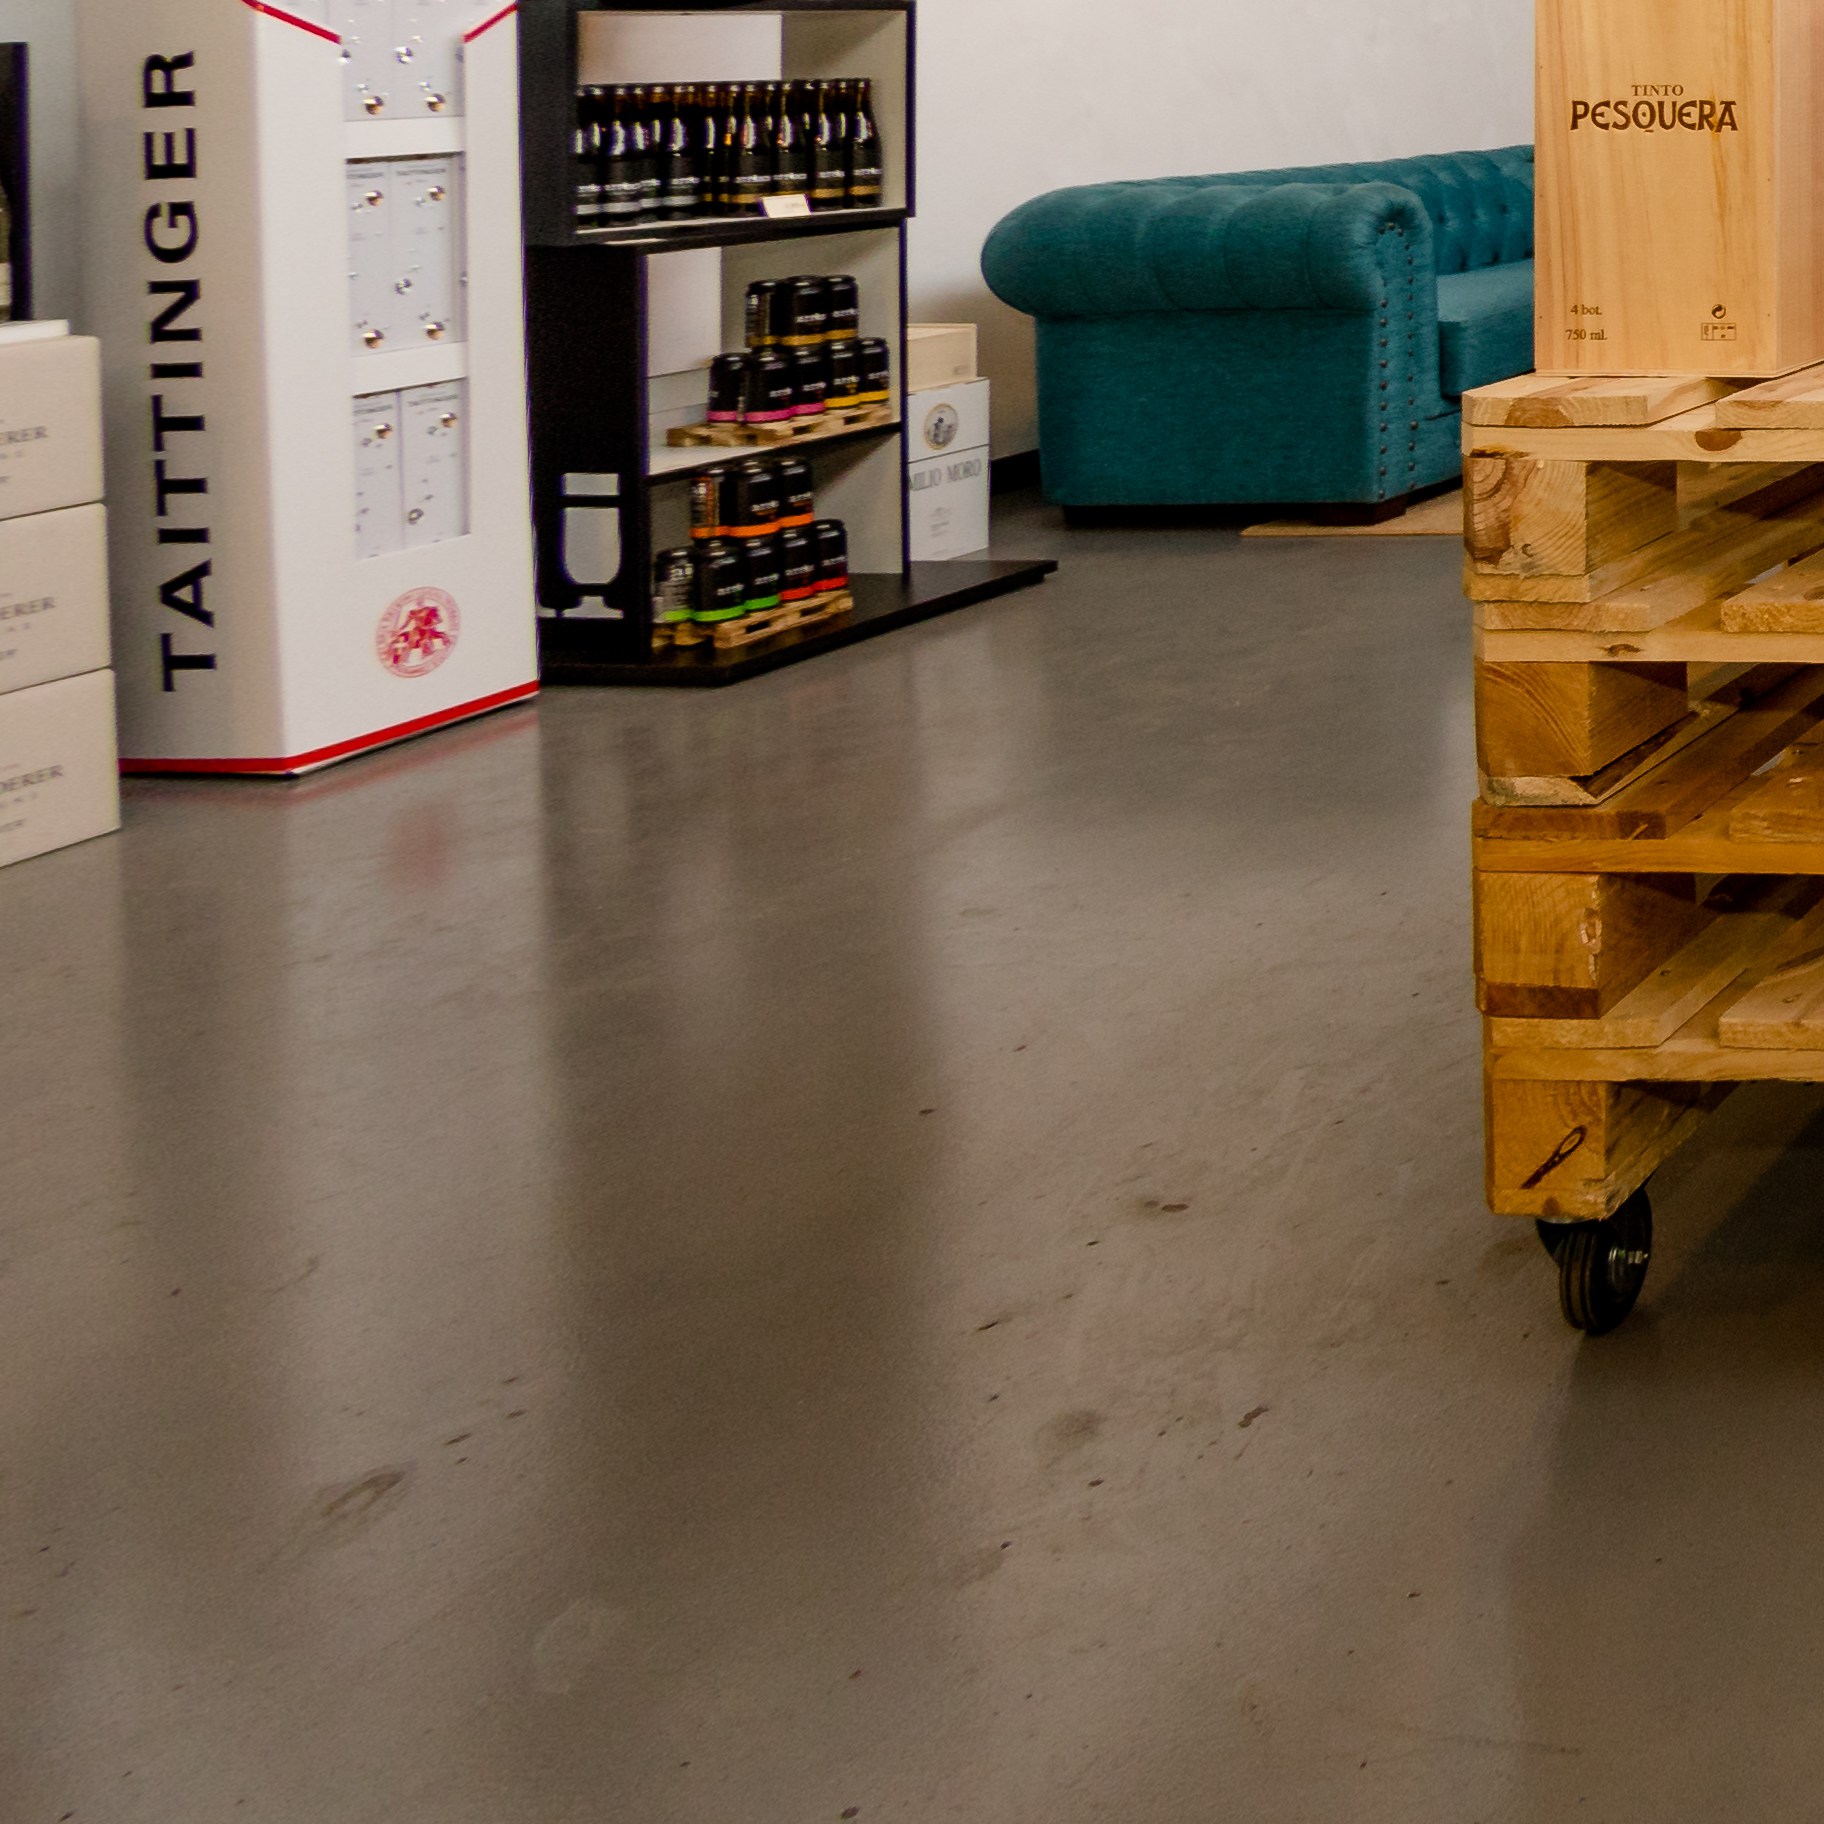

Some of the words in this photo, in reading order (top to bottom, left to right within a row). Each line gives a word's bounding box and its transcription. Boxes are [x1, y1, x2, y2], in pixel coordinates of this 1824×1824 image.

[1631, 84, 1684, 97] TINTO
[1570, 99, 1739, 133] PESQUERA
[1570, 305, 1579, 316] 4
[1581, 304, 1602, 316] bot.
[1565, 328, 1588, 341] 750
[1589, 328, 1608, 341] ml.
[143, 49, 216, 692] TAITTINGER
